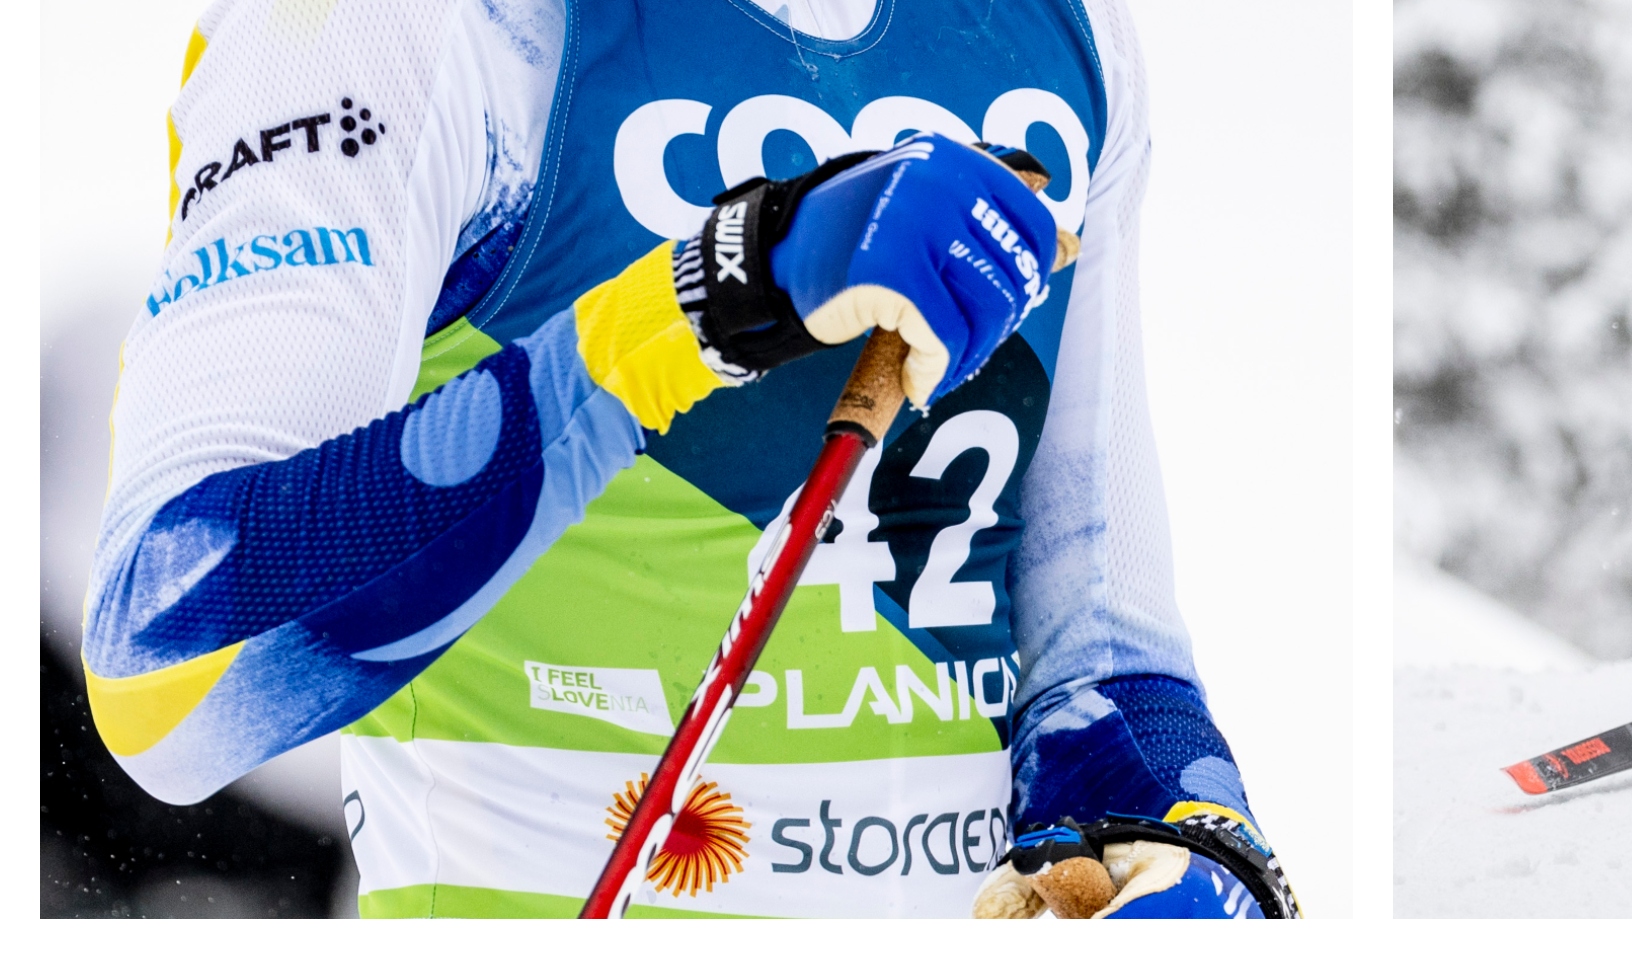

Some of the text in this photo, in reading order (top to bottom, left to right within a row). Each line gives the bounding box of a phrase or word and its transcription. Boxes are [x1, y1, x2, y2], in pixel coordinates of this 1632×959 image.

[715, 200, 748, 286] SWIX
[747, 409, 1020, 633] 42
[531, 666, 603, 690] I FEEL
[537, 684, 650, 714] SLOVENIA
